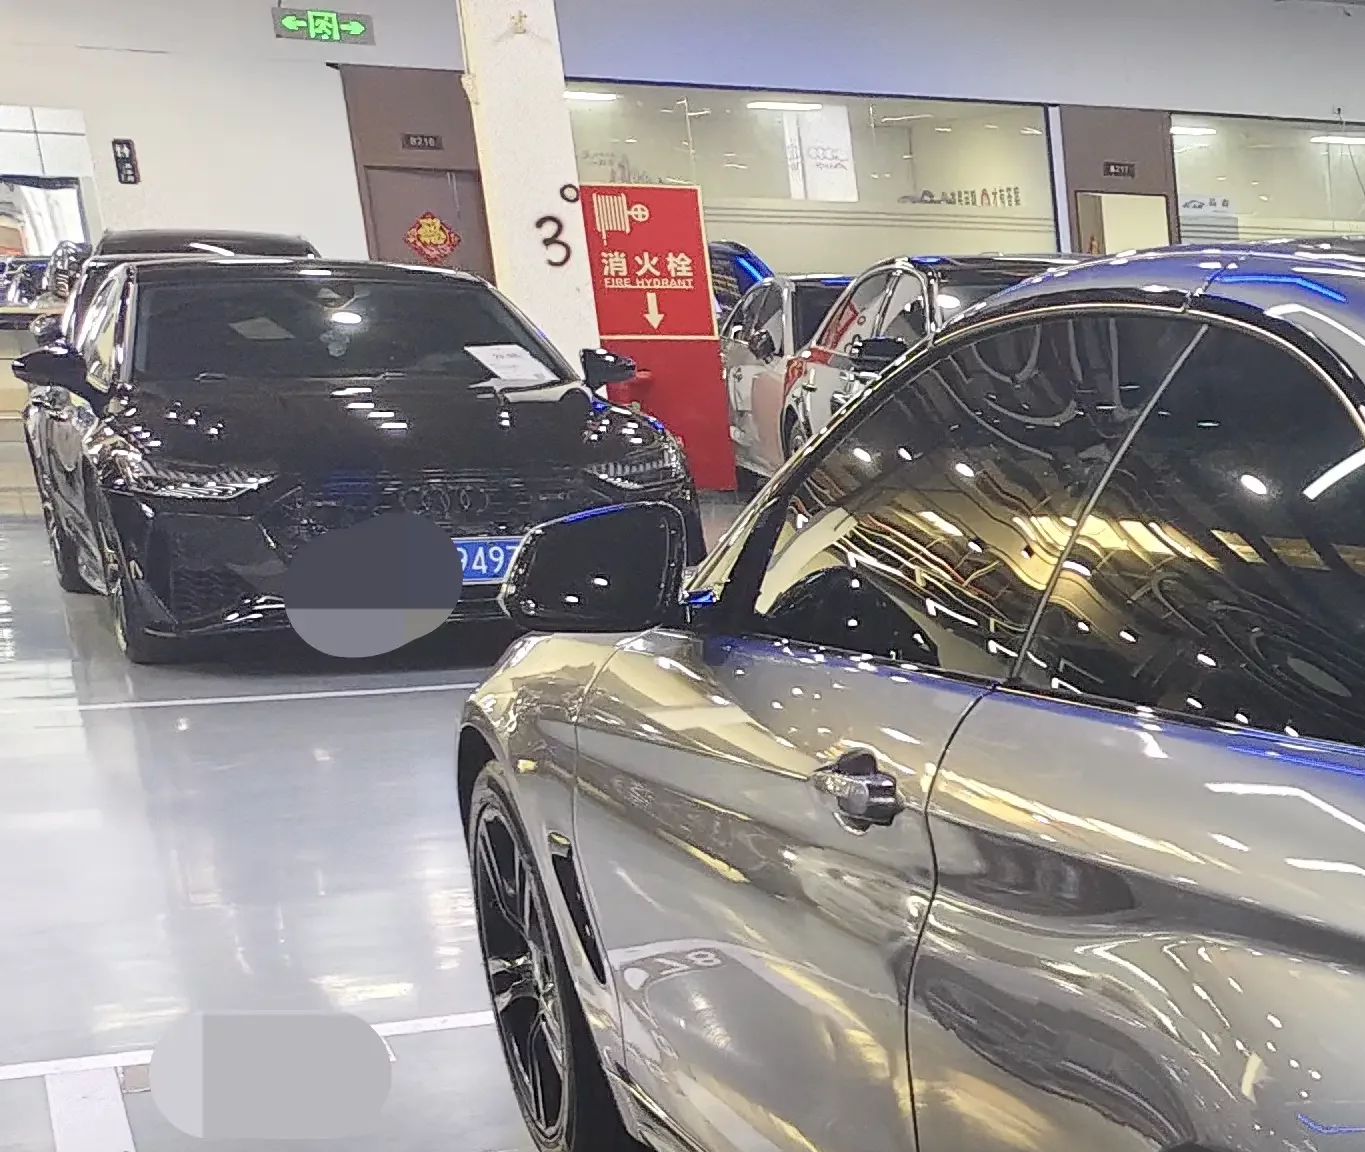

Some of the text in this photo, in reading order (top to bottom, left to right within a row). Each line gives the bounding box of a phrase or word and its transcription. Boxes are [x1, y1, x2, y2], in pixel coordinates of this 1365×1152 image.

[601, 251, 694, 277] 消火栓
[604, 278, 694, 289] FIRE HYDRANT
